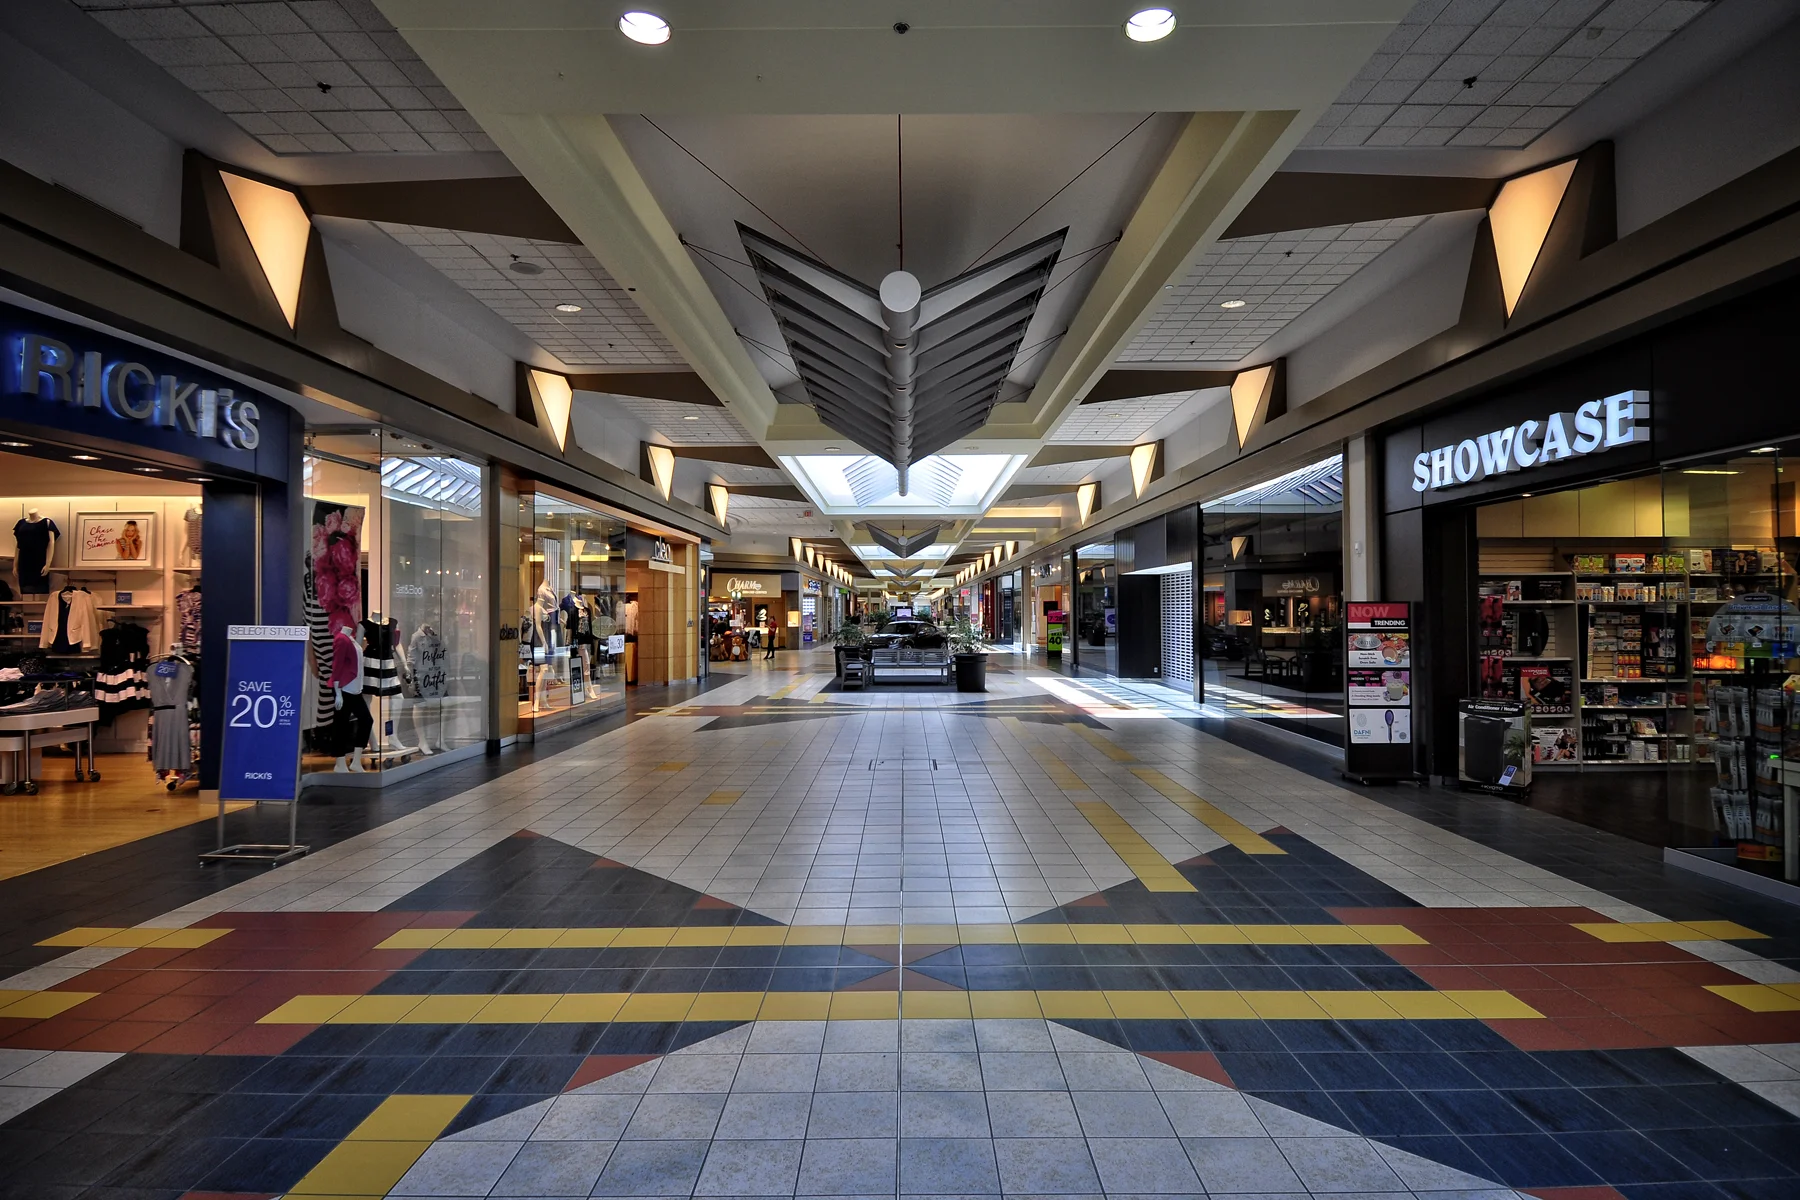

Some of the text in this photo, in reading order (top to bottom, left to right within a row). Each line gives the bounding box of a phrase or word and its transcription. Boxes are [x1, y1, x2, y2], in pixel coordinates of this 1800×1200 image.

[20, 334, 260, 450] RICKI'S
[1412, 390, 1646, 492] SHOWCASE
[90, 526, 114, 536] Chase
[94, 534, 106, 542] the
[654, 536, 671, 560] cleo
[727, 577, 757, 592] CHARM
[1350, 606, 1389, 617] NOW
[230, 626, 307, 636] SELECT STYLES
[422, 648, 447, 666] Perfect
[238, 681, 272, 692] SAVE
[423, 671, 446, 690] Outfit
[279, 696, 292, 708] %
[229, 694, 278, 728] 20
[279, 709, 295, 717] OFF
[245, 772, 272, 780] RICKI'S
